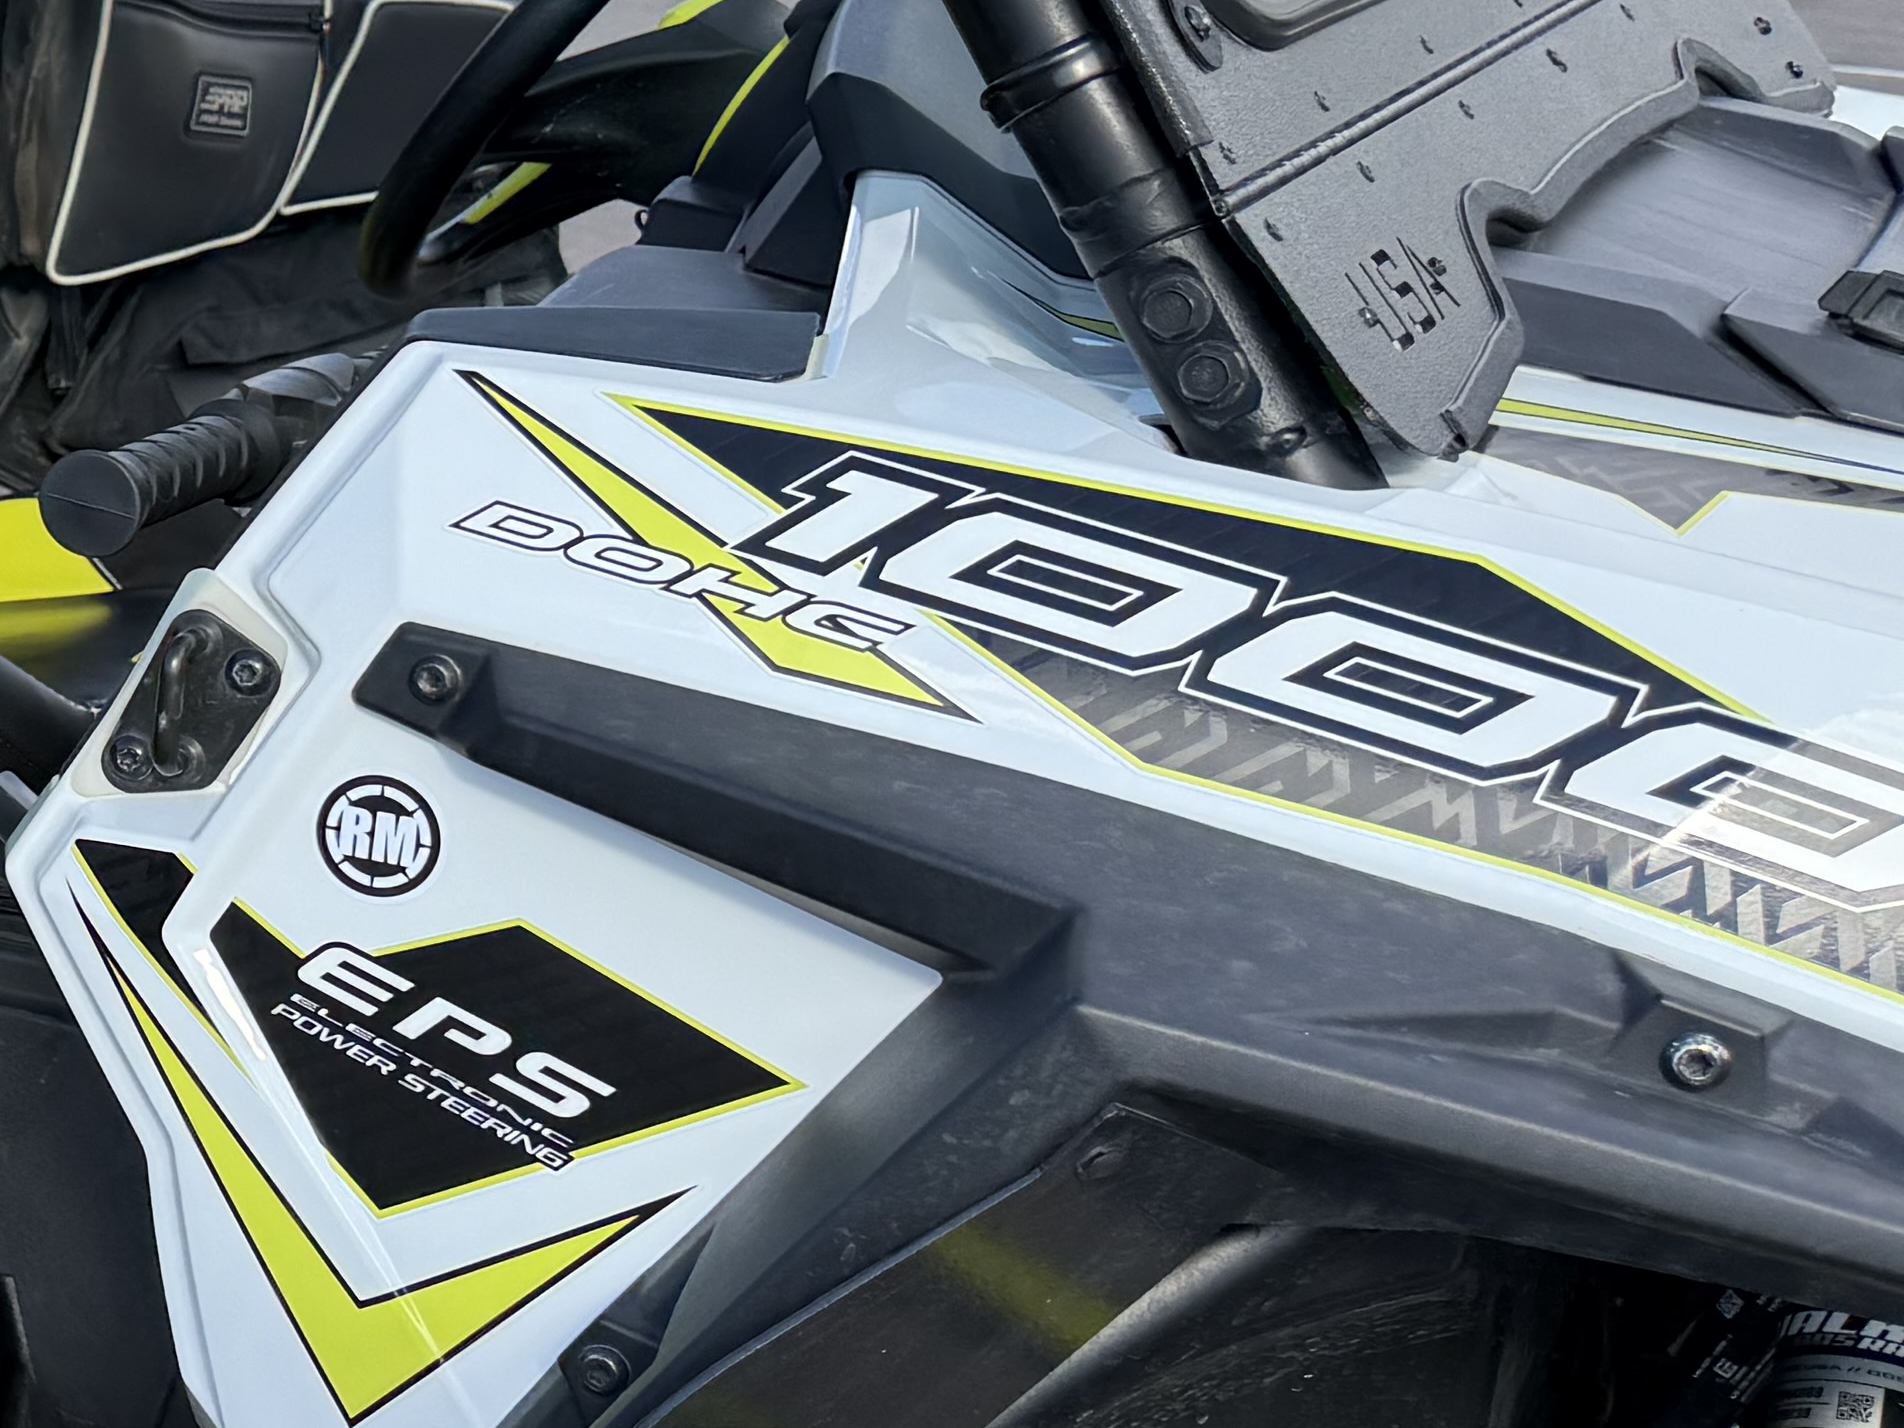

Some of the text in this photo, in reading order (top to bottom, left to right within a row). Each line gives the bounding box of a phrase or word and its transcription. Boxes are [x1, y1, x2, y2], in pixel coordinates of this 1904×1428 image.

[449, 500, 917, 653] DOHC
[730, 452, 1904, 910] 1000
[337, 804, 419, 870] RM
[270, 1002, 570, 1169] POWER STEERING
[289, 992, 575, 1149] ELECTRONIC
[297, 947, 618, 1119] EPS
